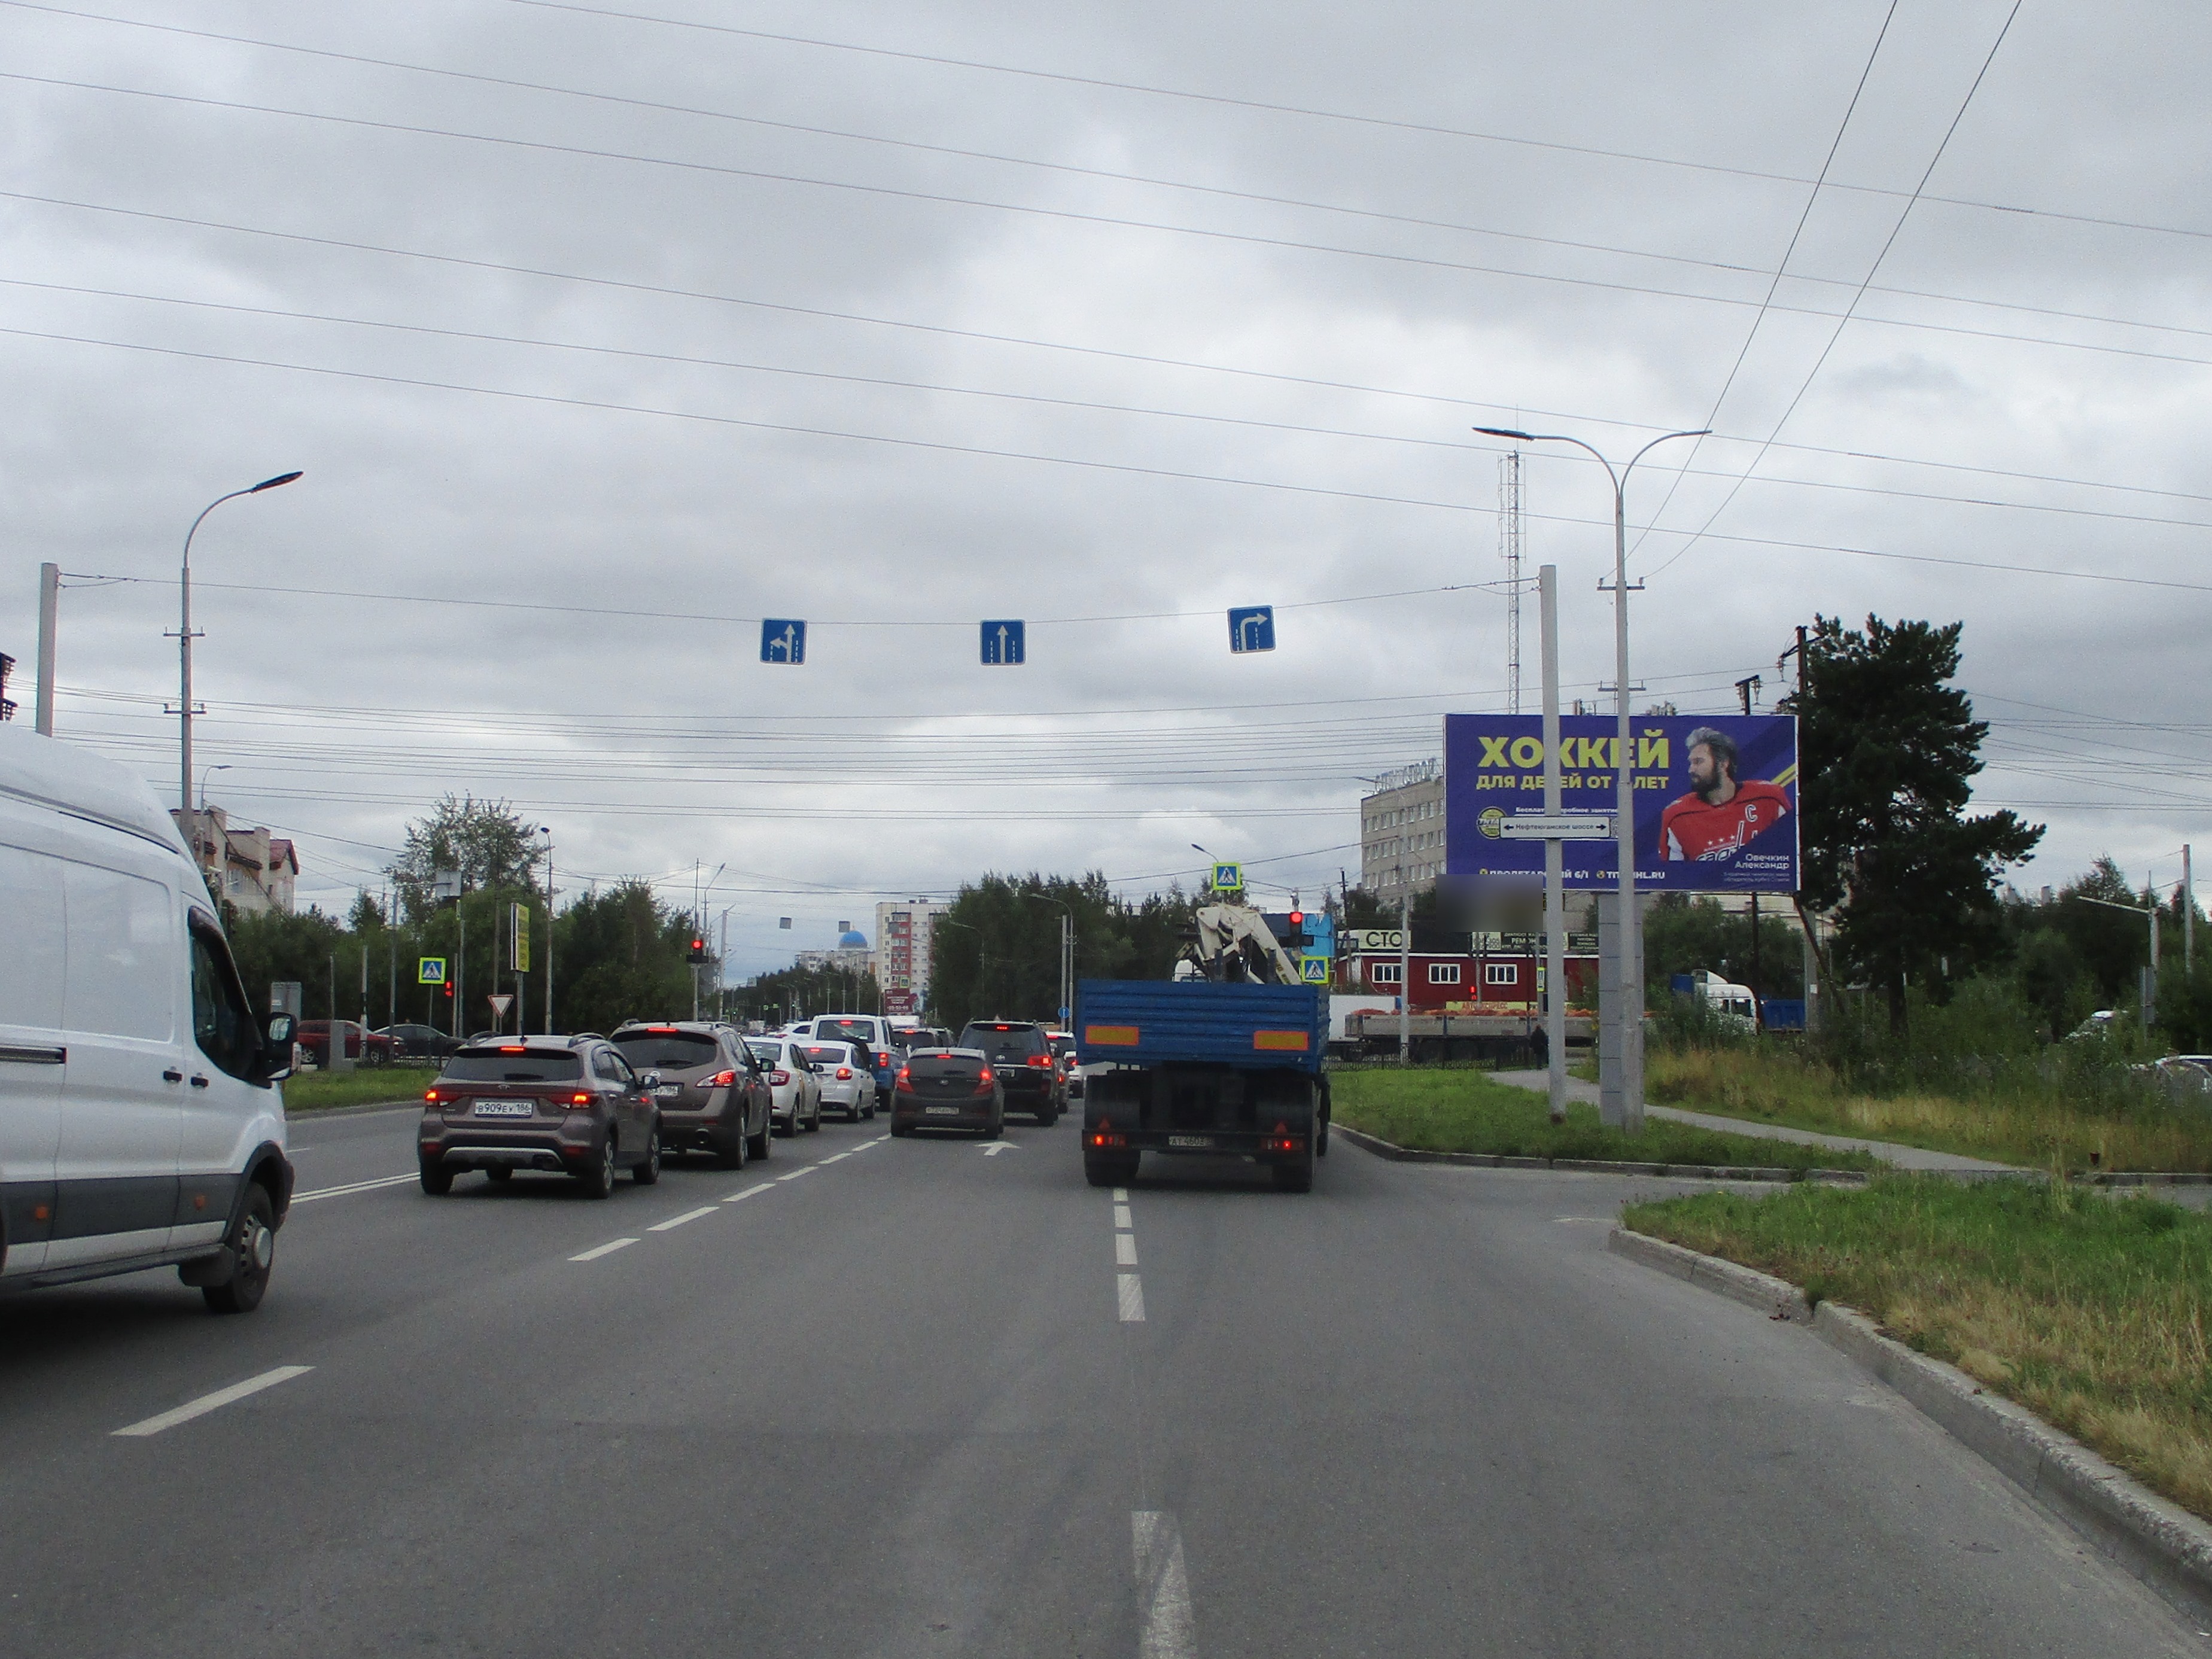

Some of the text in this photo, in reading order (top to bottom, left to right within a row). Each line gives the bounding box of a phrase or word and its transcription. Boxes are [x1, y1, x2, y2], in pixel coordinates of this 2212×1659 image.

[1477, 728, 1669, 769] ХОККЕЙ
[1476, 772, 1669, 790] ДЛЯ ДЕЕЙ ОТ ЛЕТ
[1735, 861, 1790, 870] Александр
[1745, 853, 1789, 862] Овечкин
[1366, 931, 1402, 947] СТО
